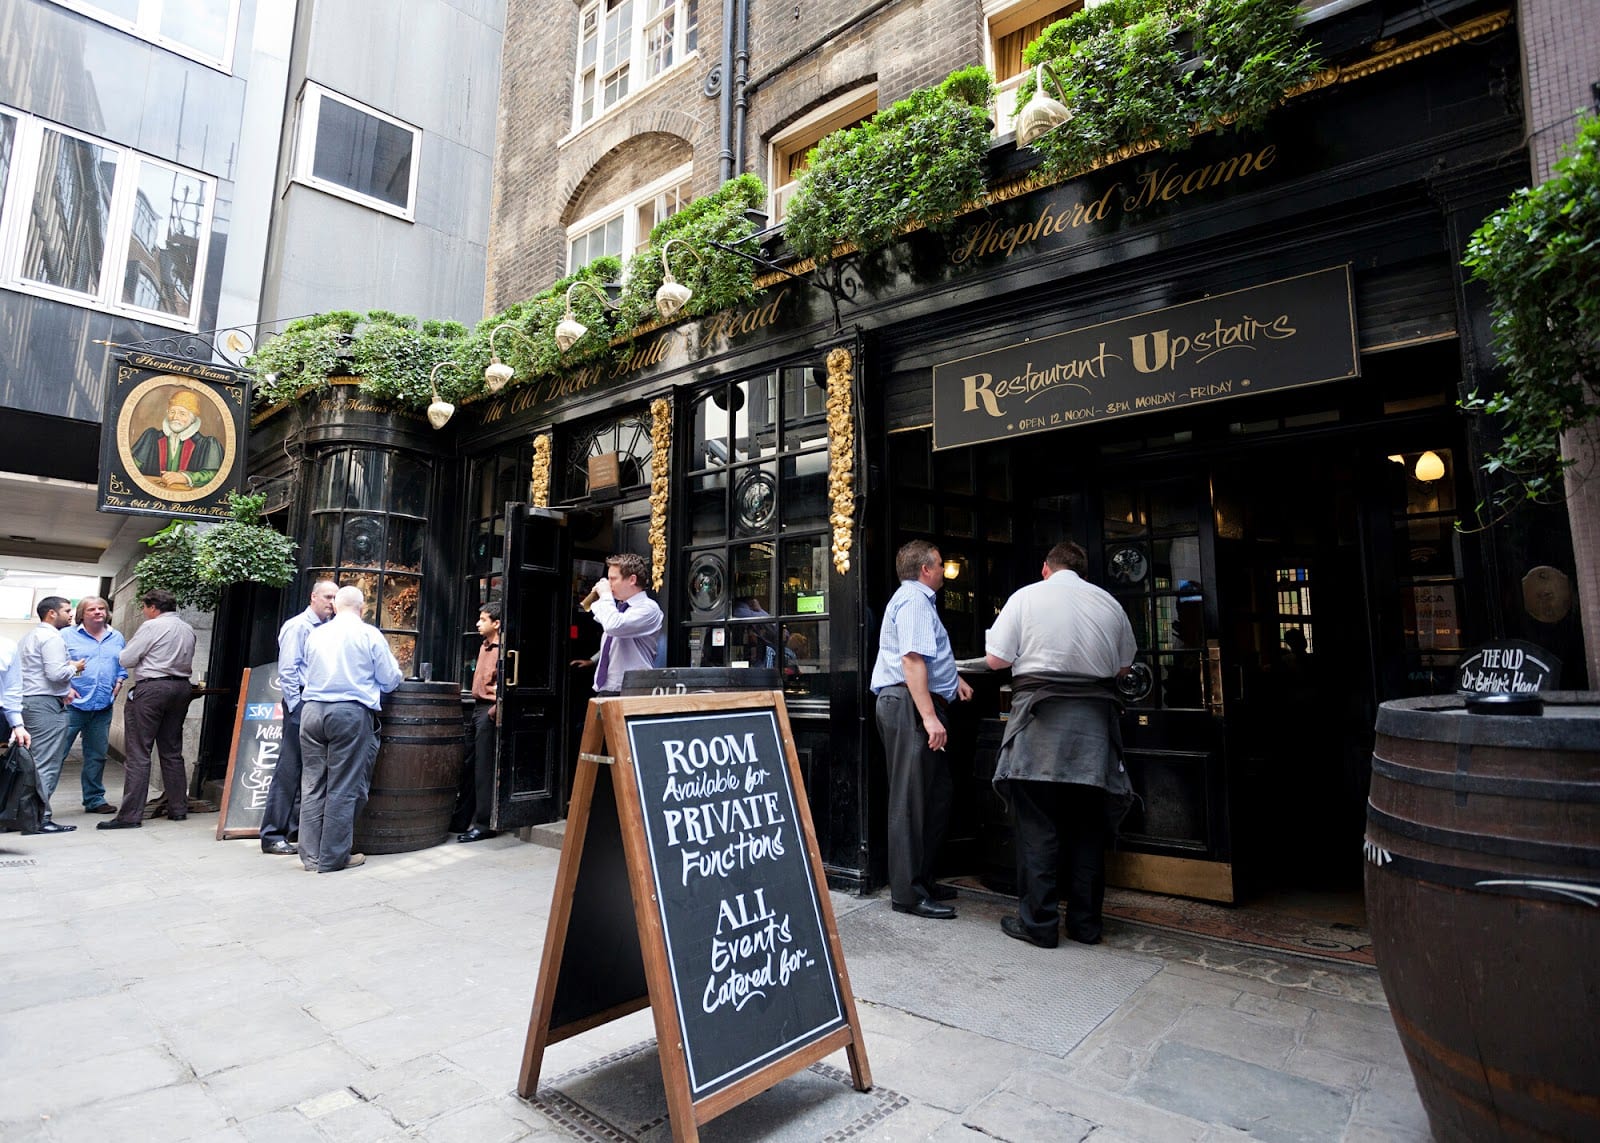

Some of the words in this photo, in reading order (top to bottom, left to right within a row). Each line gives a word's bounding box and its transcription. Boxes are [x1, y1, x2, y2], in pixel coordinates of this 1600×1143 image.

[952, 182, 1122, 264] Shepherd
[1123, 144, 1276, 212] Neame
[136, 355, 192, 374] Shepherd
[193, 366, 231, 381] Neame
[480, 399, 503, 425] The
[510, 380, 542, 414] Old
[547, 363, 602, 401] Doctor
[701, 288, 790, 347] Head
[961, 343, 1123, 418] Restaurant
[1129, 314, 1297, 374] Upstairs
[1019, 418, 1045, 430] OPEN
[1050, 413, 1062, 425] 12
[1106, 401, 1130, 414] 3PM
[1135, 392, 1176, 408] MONDAY
[1190, 380, 1233, 399] FRIDAY
[105, 496, 126, 507] The
[128, 498, 149, 509] Old
[209, 505, 231, 516] Hea
[1482, 648, 1501, 668] THE
[1501, 648, 1524, 669] OLD
[662, 733, 759, 775] ROOM
[662, 768, 739, 802] Available
[744, 765, 770, 793] for
[663, 791, 786, 847] PRIVATE
[681, 827, 785, 886] Functions
[715, 888, 776, 935] ALL
[711, 914, 793, 973] Events
[702, 953, 776, 1013] Catered
